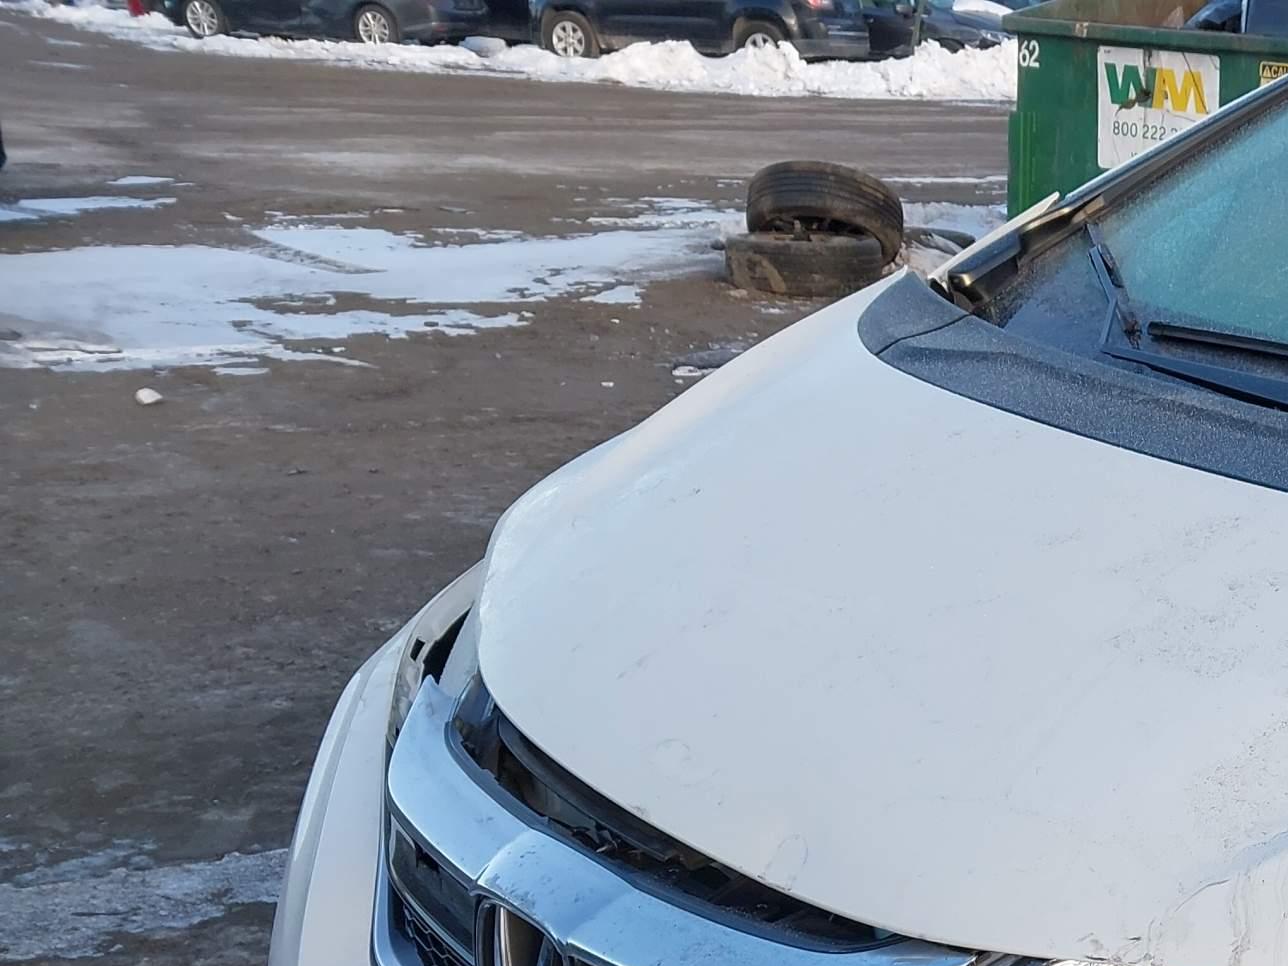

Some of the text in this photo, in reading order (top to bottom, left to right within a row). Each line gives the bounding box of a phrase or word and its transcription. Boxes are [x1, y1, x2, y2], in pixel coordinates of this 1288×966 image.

[1019, 40, 1040, 68] 62
[1103, 62, 1209, 114] WM
[1113, 121, 1138, 138] 800
[1142, 124, 1167, 141] 222
